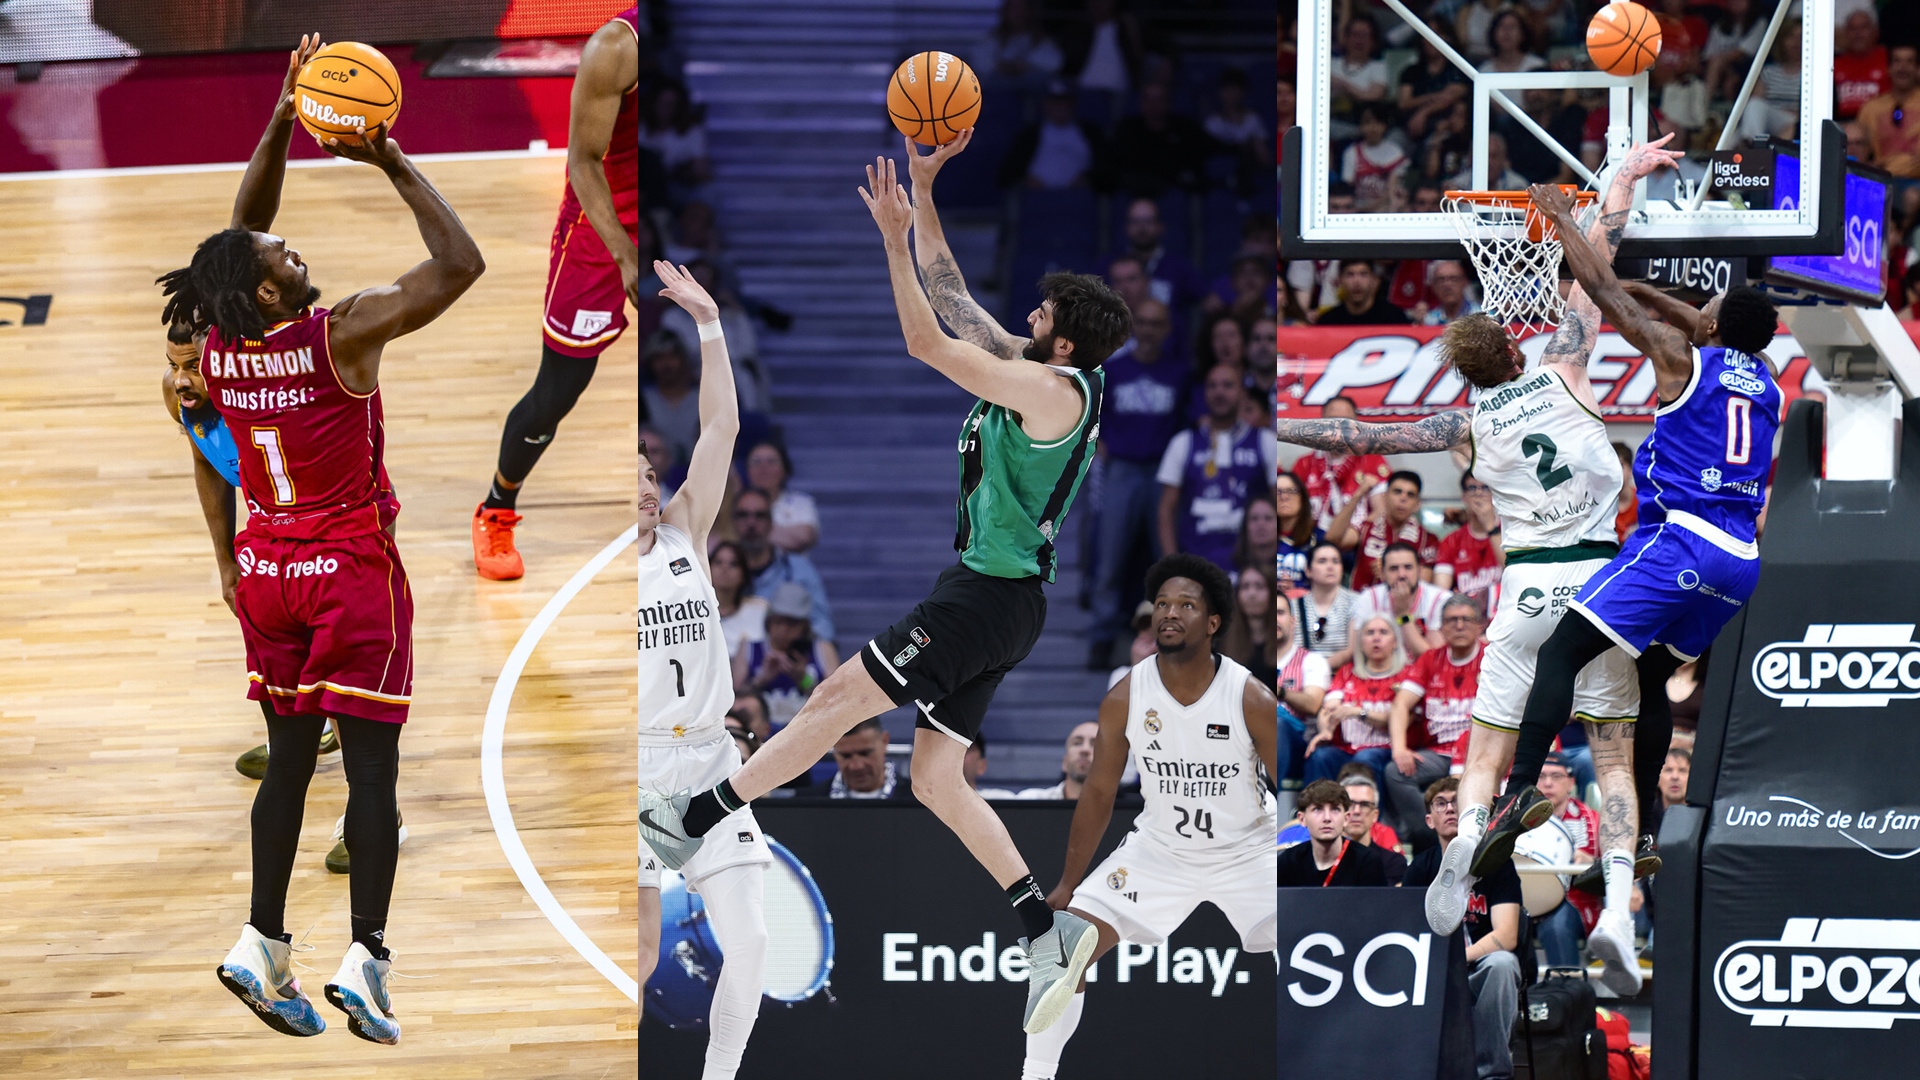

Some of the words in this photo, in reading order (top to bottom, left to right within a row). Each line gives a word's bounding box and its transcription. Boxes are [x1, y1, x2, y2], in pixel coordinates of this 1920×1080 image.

[321, 69, 349, 83] acb
[302, 93, 366, 127] Wilson
[1714, 161, 1740, 176] liga
[1714, 174, 1770, 187] endesa
[210, 346, 316, 378] BATEMON
[1477, 373, 1553, 414] ALCEROWSKI
[1726, 395, 1752, 465] 0
[250, 426, 297, 506] 1
[1521, 433, 1573, 492] 2
[271, 517, 296, 526] Grupo
[663, 622, 706, 647] BETTER
[669, 658, 686, 698] 1
[1142, 756, 1240, 779] Emirates
[1159, 780, 1179, 794] FLY
[1183, 781, 1227, 798] BETTER
[1173, 805, 1214, 839] 24
[1725, 806, 1772, 827] Uno
[1777, 808, 1821, 828] más
[1826, 810, 1852, 829] de
[1857, 812, 1877, 829] la
[1117, 937, 1251, 997] Play.
